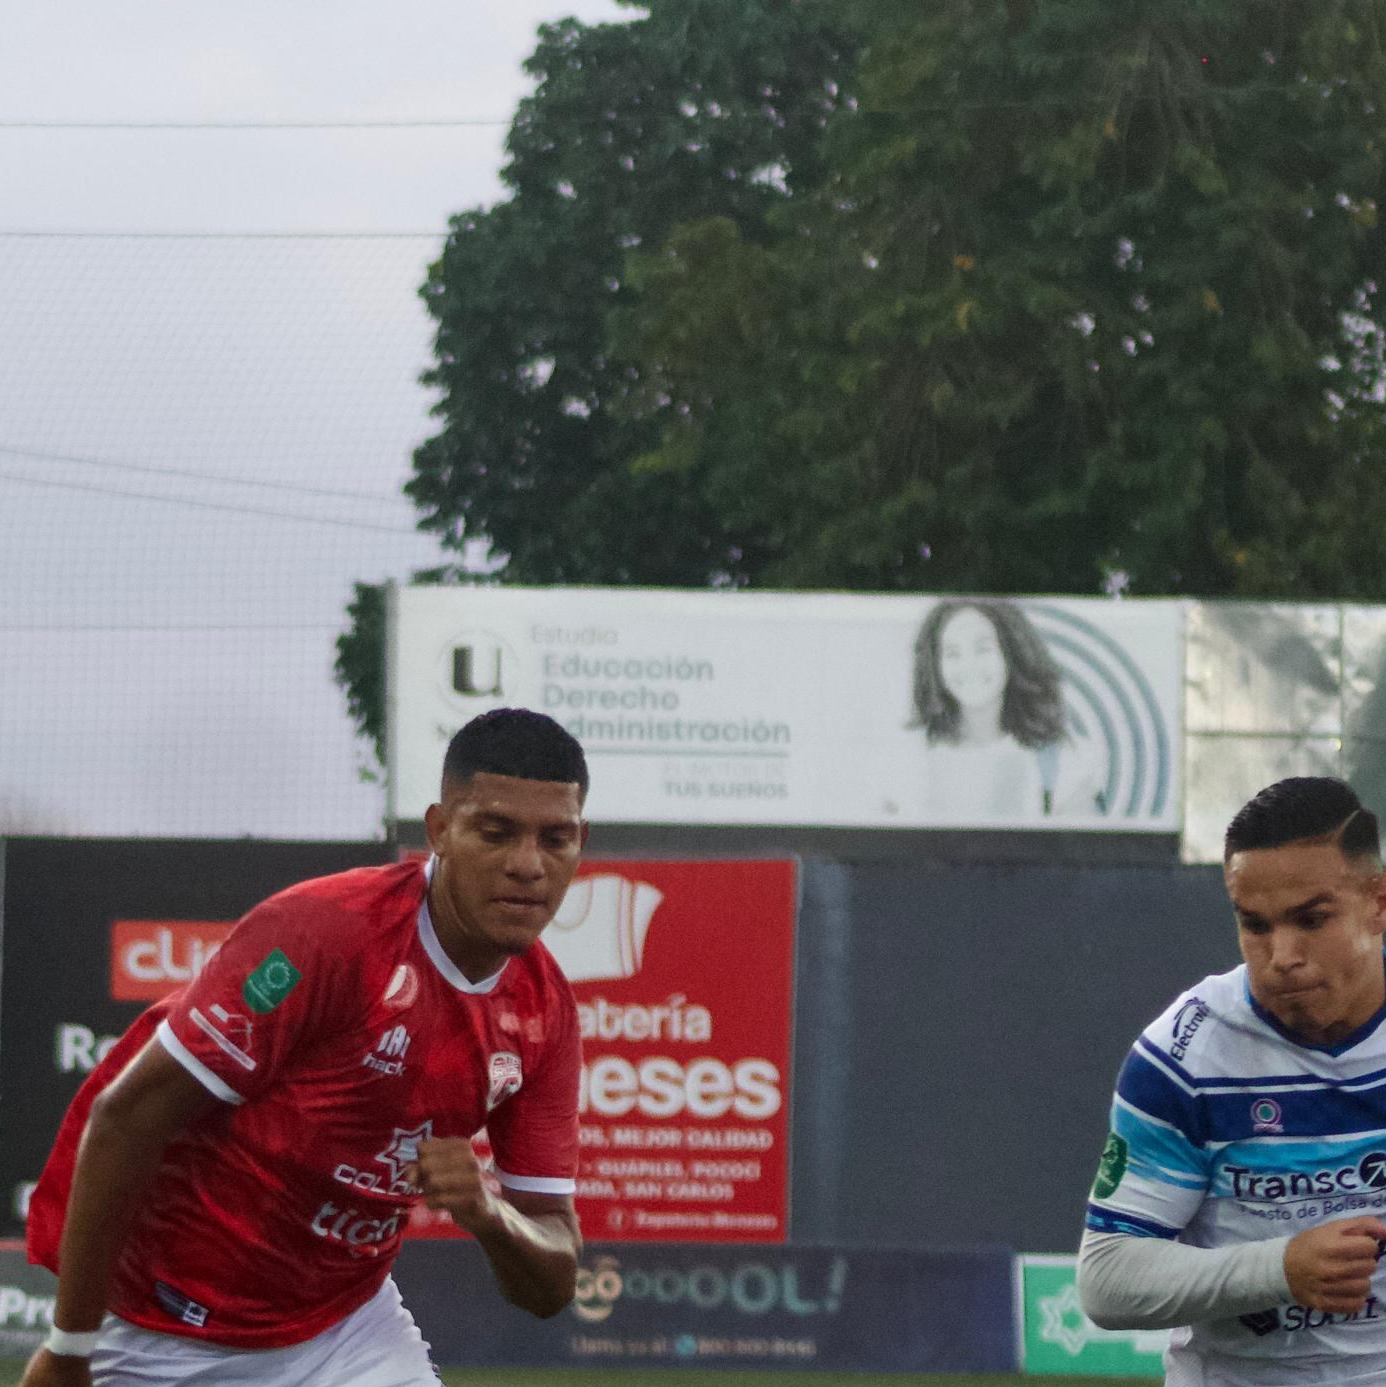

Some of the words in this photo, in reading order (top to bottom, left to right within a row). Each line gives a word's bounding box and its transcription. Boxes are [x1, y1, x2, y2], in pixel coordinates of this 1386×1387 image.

[542, 651, 714, 681] Educación
[542, 684, 679, 711] Derecho
[570, 716, 791, 745] dministración
[613, 1128, 683, 1148] MEJOR
[687, 1129, 774, 1150] CALIDAD
[1323, 1198, 1366, 1215] Bolsa
